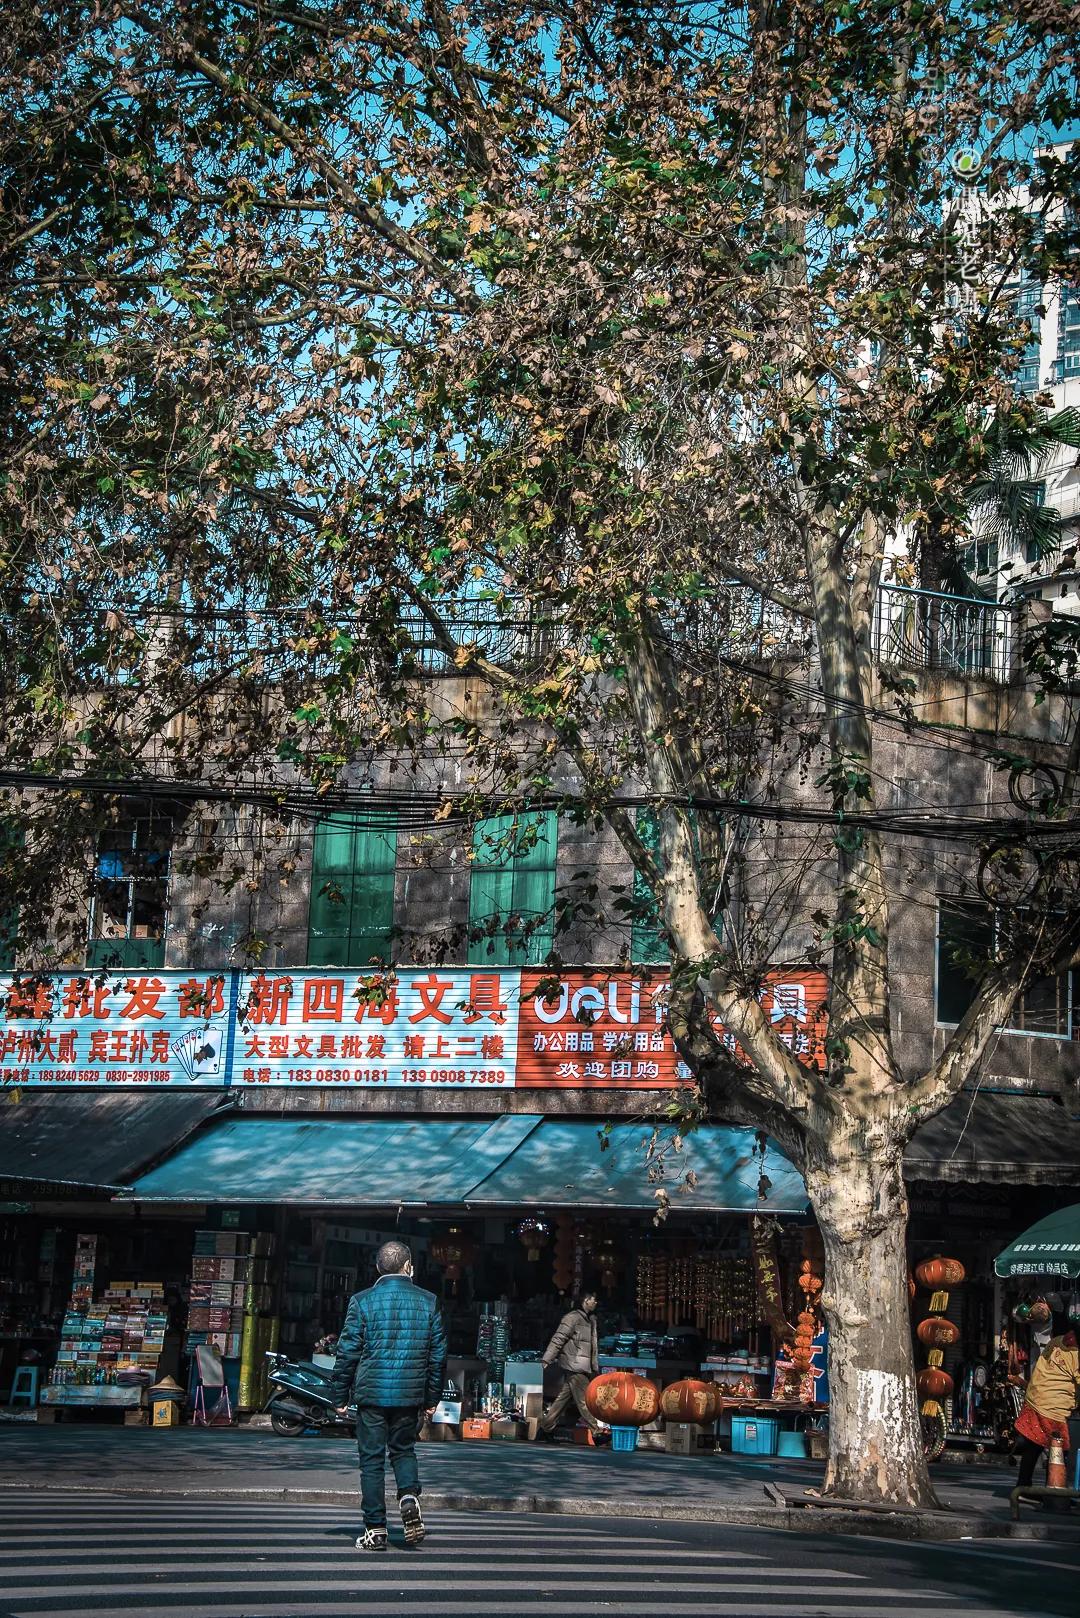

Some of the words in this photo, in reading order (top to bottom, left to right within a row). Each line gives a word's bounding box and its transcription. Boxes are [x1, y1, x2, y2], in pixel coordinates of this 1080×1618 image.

[248, 973, 508, 1026] 新四海文具
[88, 1029, 171, 1064] 宾王扑克
[245, 1034, 387, 1059] 大型文具批发
[402, 1034, 505, 1060] 请上二楼
[533, 1031, 594, 1052] 办公用品
[555, 1060, 660, 1079] 欢迎团购
